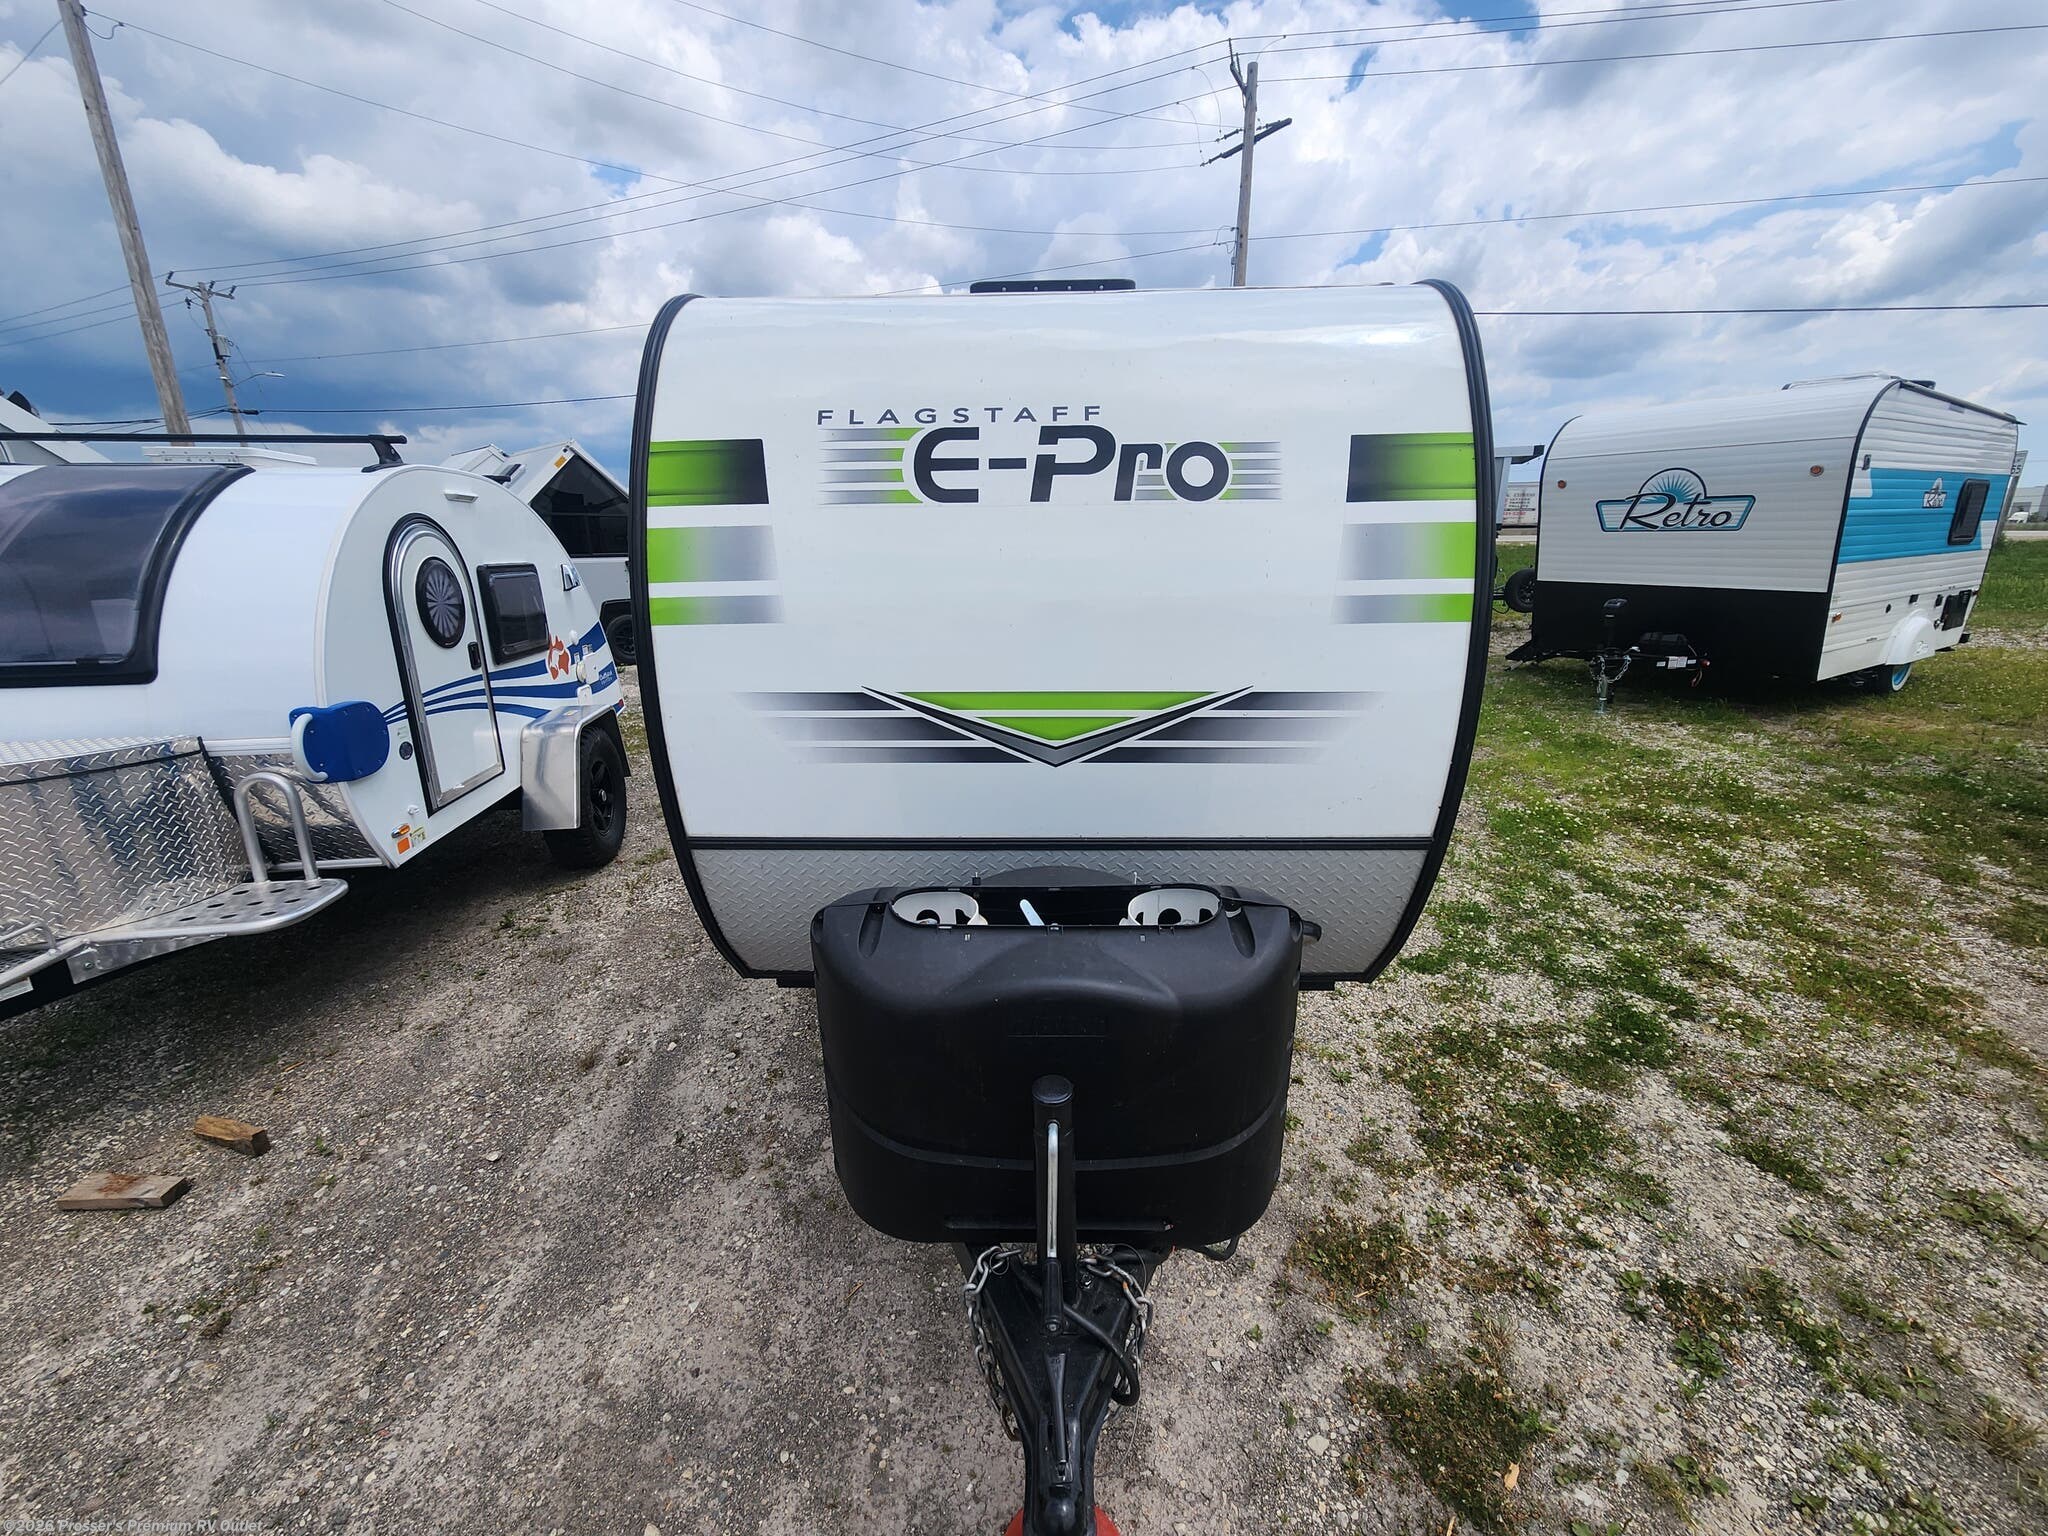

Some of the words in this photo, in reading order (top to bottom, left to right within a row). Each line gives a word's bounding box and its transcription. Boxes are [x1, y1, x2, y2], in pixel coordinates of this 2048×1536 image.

[817, 405, 1101, 426] FLAGSTAFF
[913, 424, 1230, 503] E-Pro
[1619, 492, 1732, 529] Retro
